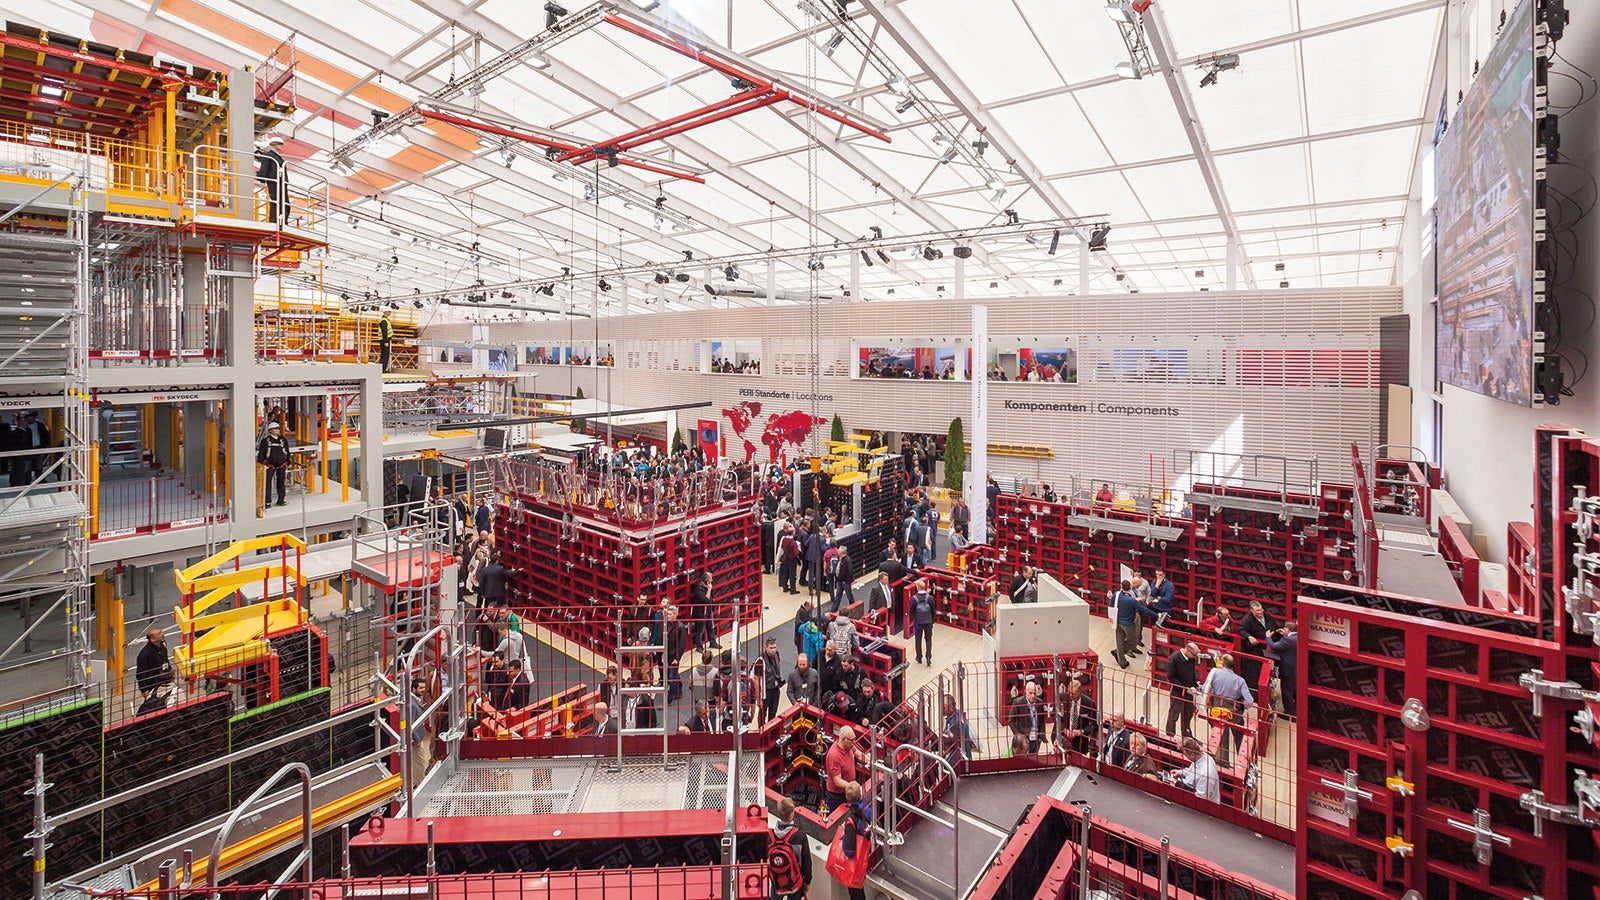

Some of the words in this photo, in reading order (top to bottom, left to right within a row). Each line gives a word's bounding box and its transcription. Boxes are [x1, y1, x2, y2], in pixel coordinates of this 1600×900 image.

[739, 388, 754, 397] PERI
[755, 389, 790, 399] Standorte
[796, 391, 834, 401] Locations
[1004, 400, 1087, 412] Komponenten
[1097, 403, 1180, 416] Components
[1315, 611, 1345, 625] PERI
[1310, 624, 1346, 637] MAXIMO
[1308, 798, 1345, 815] MAXIMO
